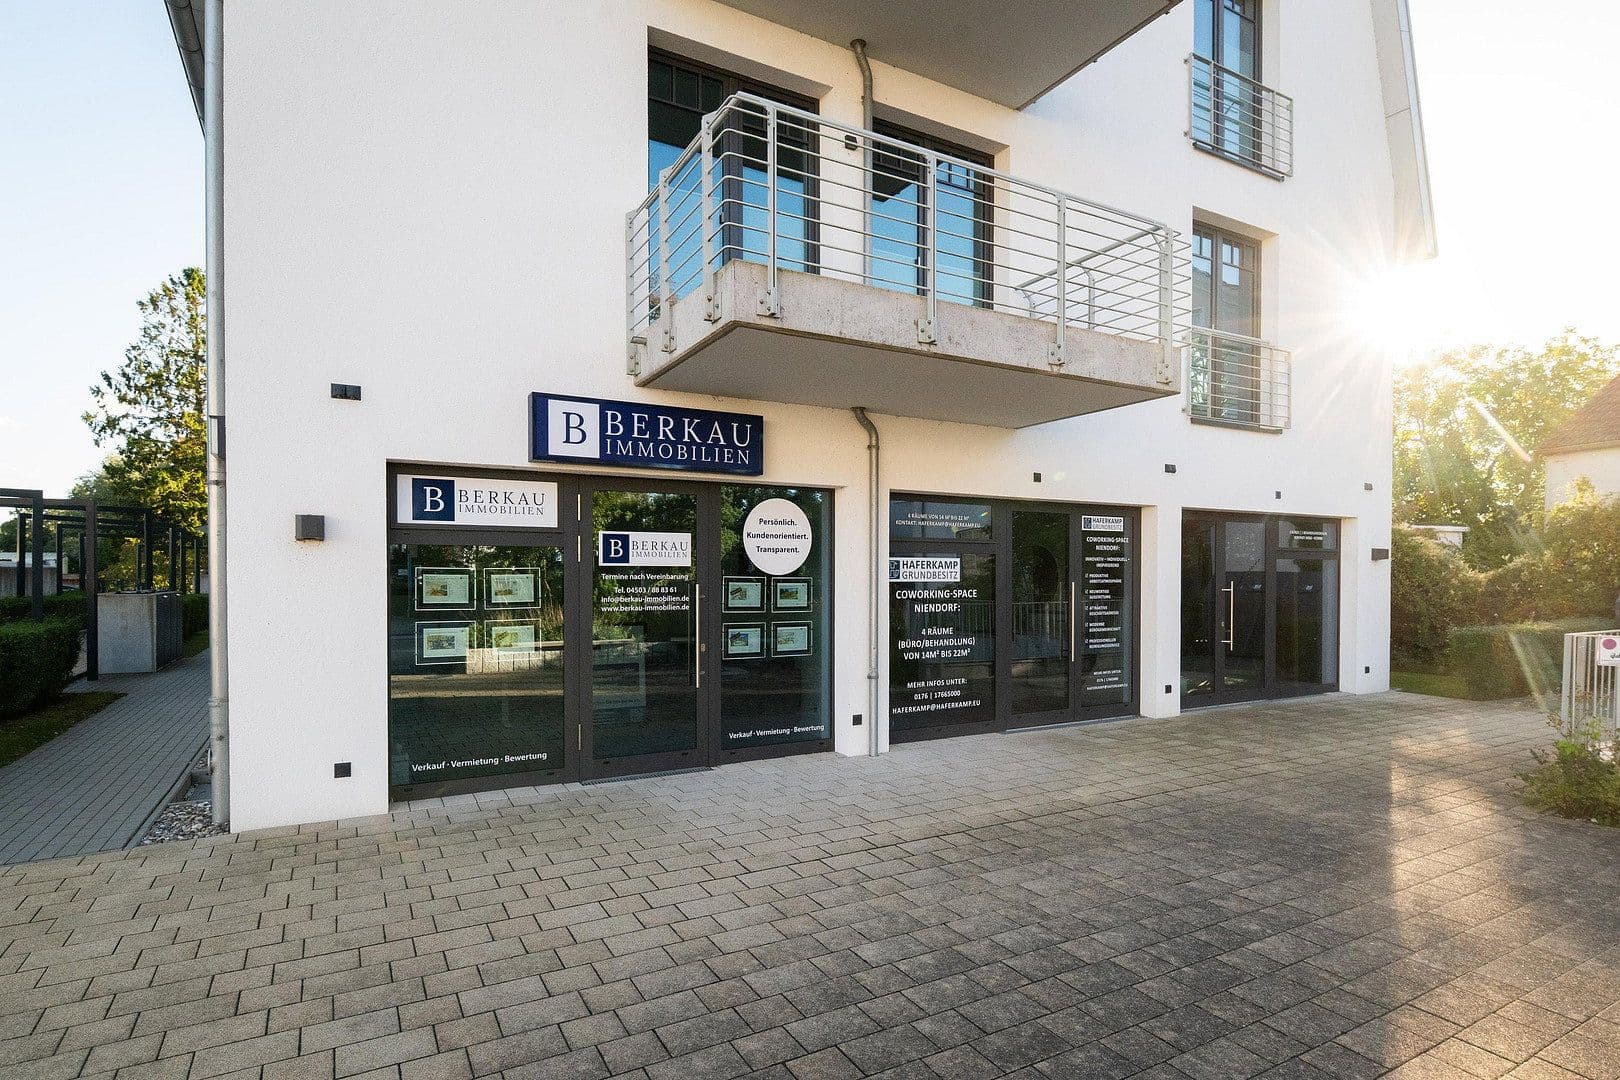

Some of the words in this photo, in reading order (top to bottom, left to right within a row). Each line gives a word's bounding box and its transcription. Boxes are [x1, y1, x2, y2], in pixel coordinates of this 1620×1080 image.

[562, 412, 587, 444] B
[605, 411, 752, 447] BERKAU
[606, 439, 749, 465] IMMOBILIEN
[424, 486, 445, 512] B
[458, 489, 545, 506] BERKAU
[459, 504, 544, 515] IMMOBILIEN
[759, 518, 797, 526] Persönlich.
[747, 531, 809, 540] Kundenorientiert.
[609, 539, 623, 557] B
[632, 541, 688, 551] BERKAU
[756, 546, 800, 554] Transparent.
[902, 560, 958, 570] HAFERKAMP
[646, 573, 689, 581] Vereinbarung
[902, 571, 958, 580] GRUNDBESITZ
[601, 595, 690, 603] info@berkau-immobilien.de
[895, 590, 978, 599] COWORKING-SPACE
[600, 604, 690, 612] www.berkau-immobilien.de
[914, 603, 961, 613] NIENDORF:
[927, 626, 954, 635] RÄUME
[898, 636, 976, 650] (BÜRO/BEHANDLUNG)
[904, 652, 920, 660] VON
[921, 650, 940, 659] 14M²
[941, 650, 952, 658] BIS
[953, 648, 971, 657] 22M²
[907, 681, 926, 689] MEHR
[913, 692, 929, 700] 0176
[892, 700, 981, 714] HAFERKAMP@HAFERKAMP.EU
[729, 731, 753, 739] Verkauf
[756, 728, 791, 737] Vermietung
[793, 724, 825, 733] Bewertung
[411, 761, 446, 772] Verkauf
[450, 756, 499, 768] Vermietung
[504, 751, 548, 763] Bewertung
